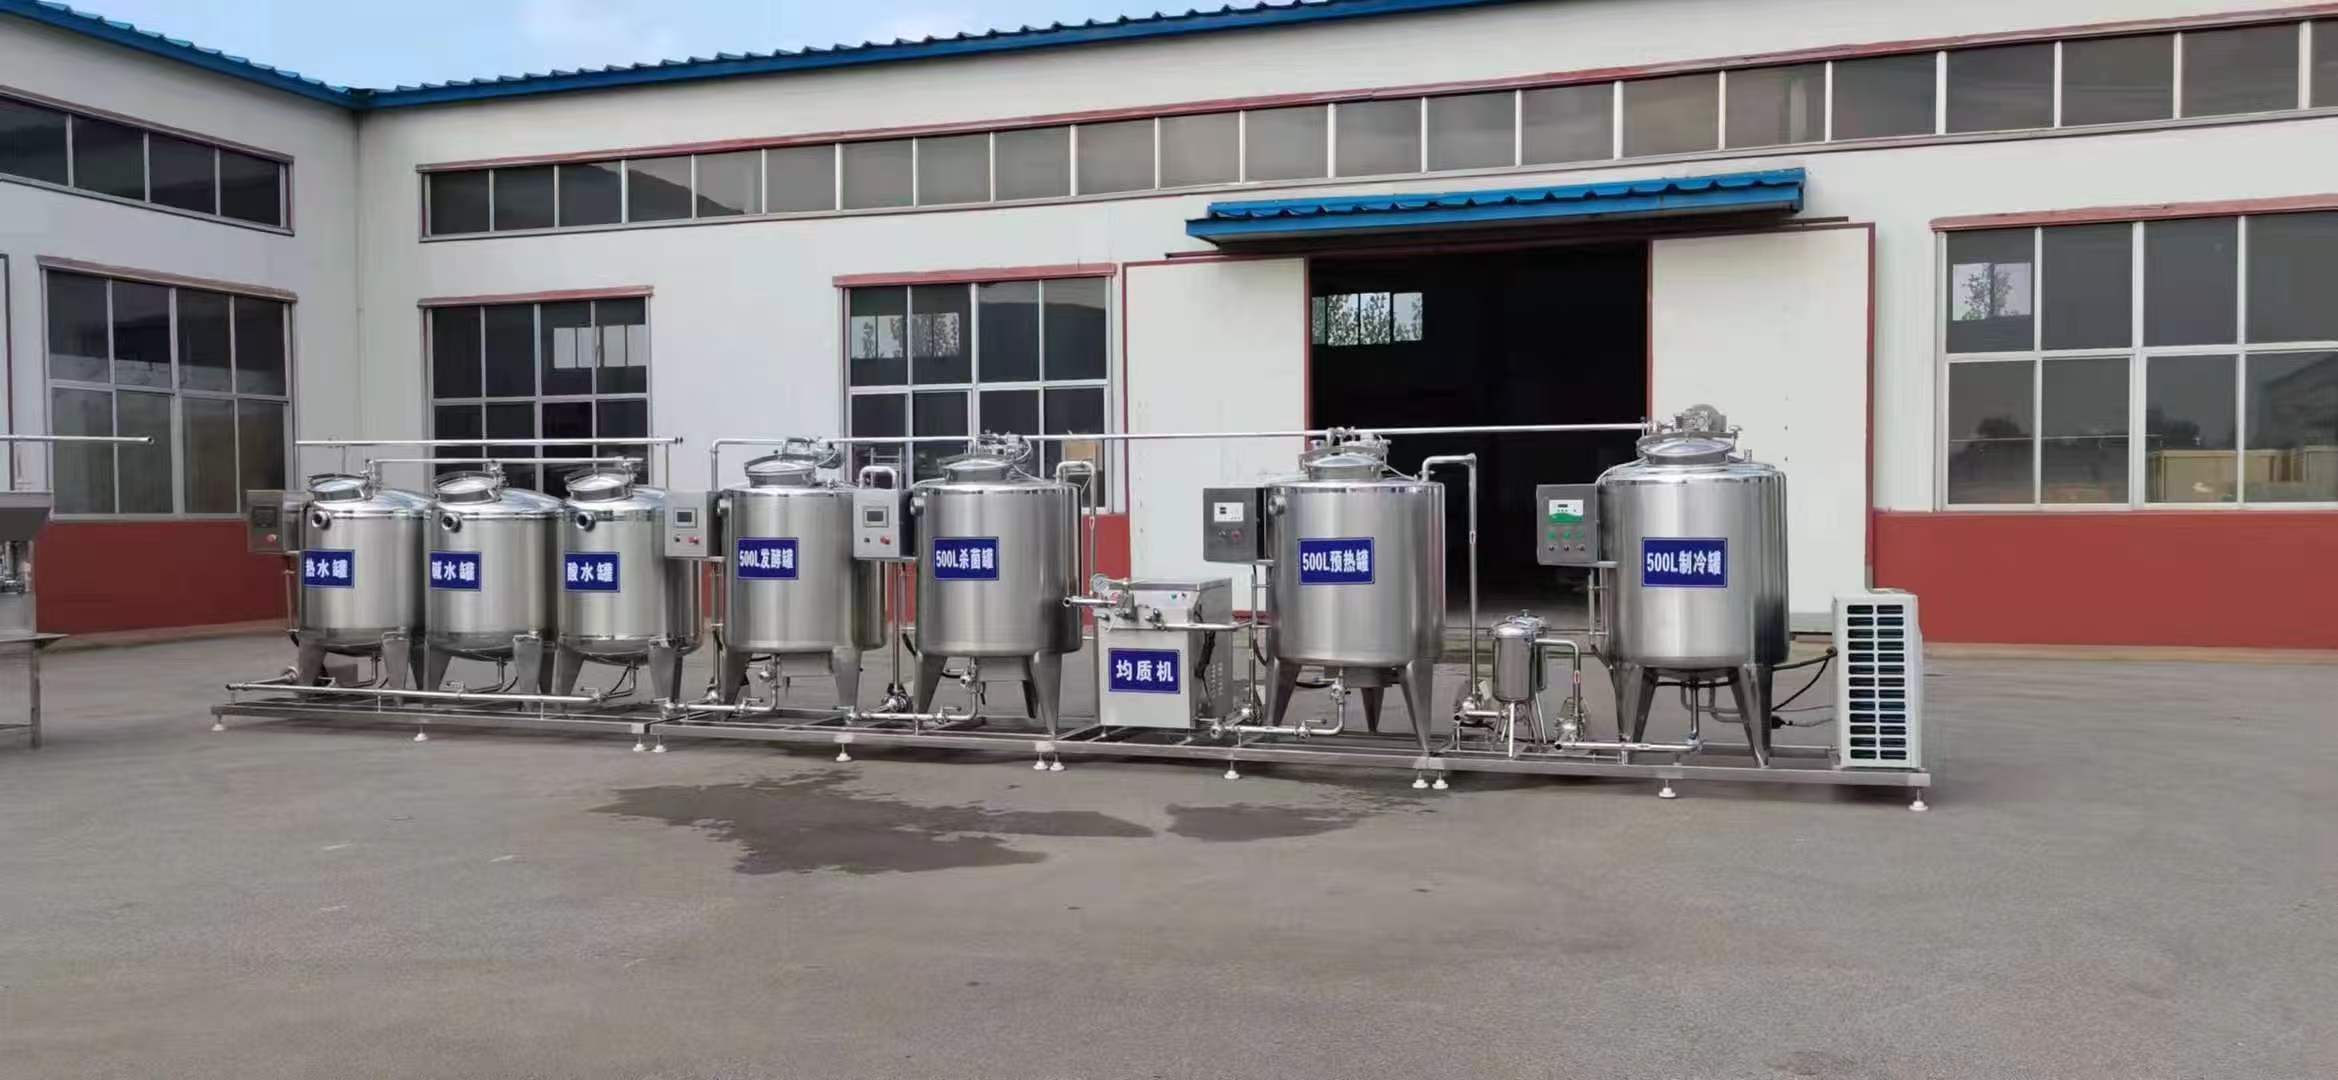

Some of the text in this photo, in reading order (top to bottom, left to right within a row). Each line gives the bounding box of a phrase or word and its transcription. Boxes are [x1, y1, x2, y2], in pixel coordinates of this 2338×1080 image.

[305, 558, 348, 579] 热水罐
[740, 549, 794, 569] 500L发酵罐
[936, 548, 994, 570] 500L杀菌罐
[1302, 549, 1369, 573] 500L预热罐
[1647, 550, 1721, 576] 500L制冷罐
[567, 561, 613, 582] 酸水罐
[1115, 659, 1174, 682] 均质机
